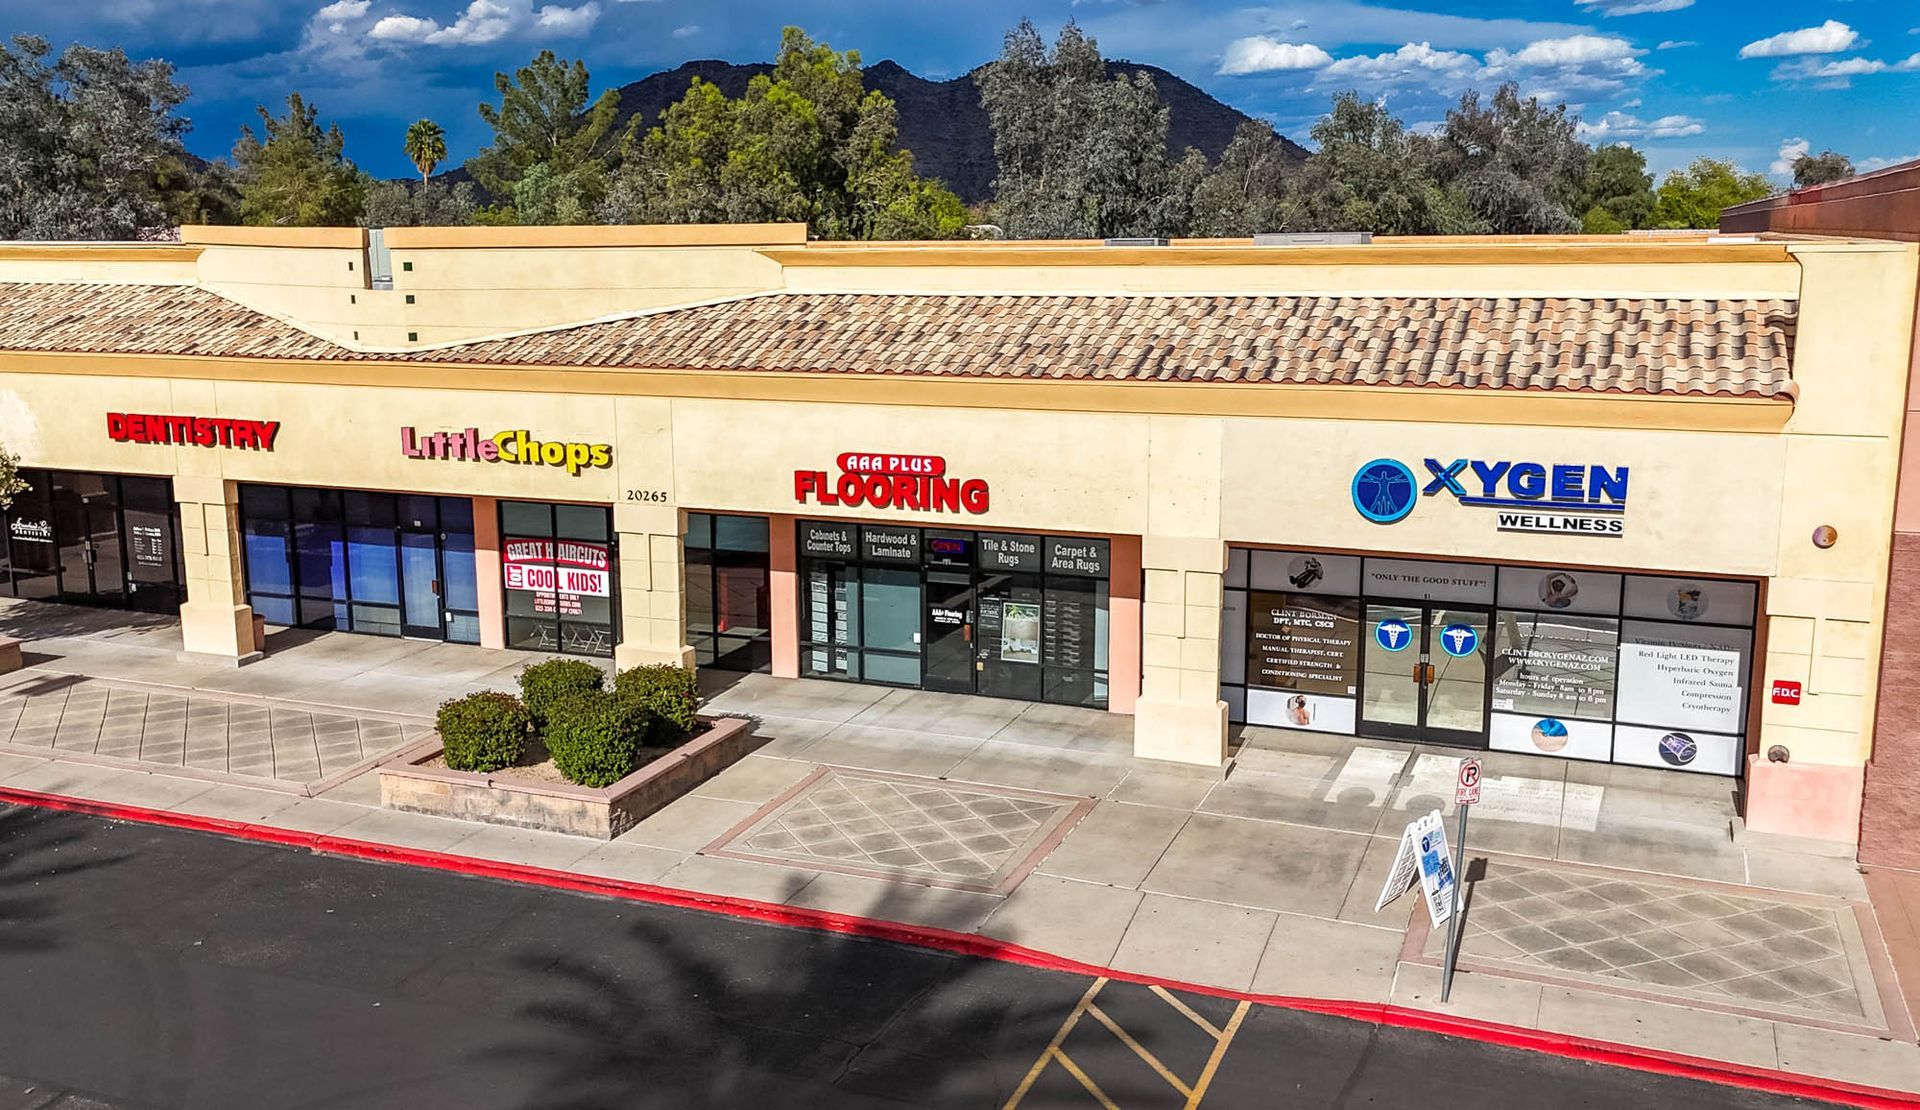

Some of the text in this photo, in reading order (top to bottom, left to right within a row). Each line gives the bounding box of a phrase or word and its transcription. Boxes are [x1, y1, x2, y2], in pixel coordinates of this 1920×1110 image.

[107, 412, 280, 452] DENTISTRY
[847, 456, 932, 472] AAA PLUS
[627, 489, 667, 502] 20265
[794, 470, 989, 515] FLOORING
[1500, 515, 1623, 532] WELLNESS
[810, 529, 847, 541] Cabinets &
[866, 532, 917, 546] Hardwood &
[507, 543, 542, 561] GREAT
[807, 540, 851, 554] Counter Tops
[872, 546, 911, 559] Laminate
[983, 539, 1035, 553] Tile & Stone
[1055, 544, 1097, 558] Carpet &
[998, 553, 1019, 566] Rugs
[1052, 557, 1100, 573] Area Rugs
[528, 569, 602, 593] COOL KIDS!
[1401, 575, 1420, 583] THE
[1423, 576, 1449, 585] GOOD
[1271, 609, 1297, 617] CLINT
[1256, 632, 1281, 640] DOCTOR
[1292, 636, 1321, 644] PHYSICAL
[1322, 638, 1352, 646] THERAPY
[1262, 645, 1289, 653] MANUAL
[1266, 657, 1298, 666] CERTIFIED
[1300, 660, 1333, 668] STRENGTH
[1509, 657, 1601, 671] WWW.OXYGENAZ.COM
[1639, 650, 1733, 665] Red Light LED Therapy
[1262, 669, 1343, 681] CONDITIONING SPECIALIST
[1657, 664, 1733, 676] Hyperbaric Oxygen
[1499, 679, 1526, 689] Monday
[1533, 683, 1555, 691] Friday
[1520, 672, 1539, 681] hours
[1552, 676, 1584, 685] operation
[1673, 677, 1732, 688] Infrared Sauna
[1496, 687, 1525, 697] Saturday
[1532, 690, 1557, 700] Sunday
[1681, 690, 1732, 700] Compression
[1682, 702, 1730, 713] Cryotherapy
